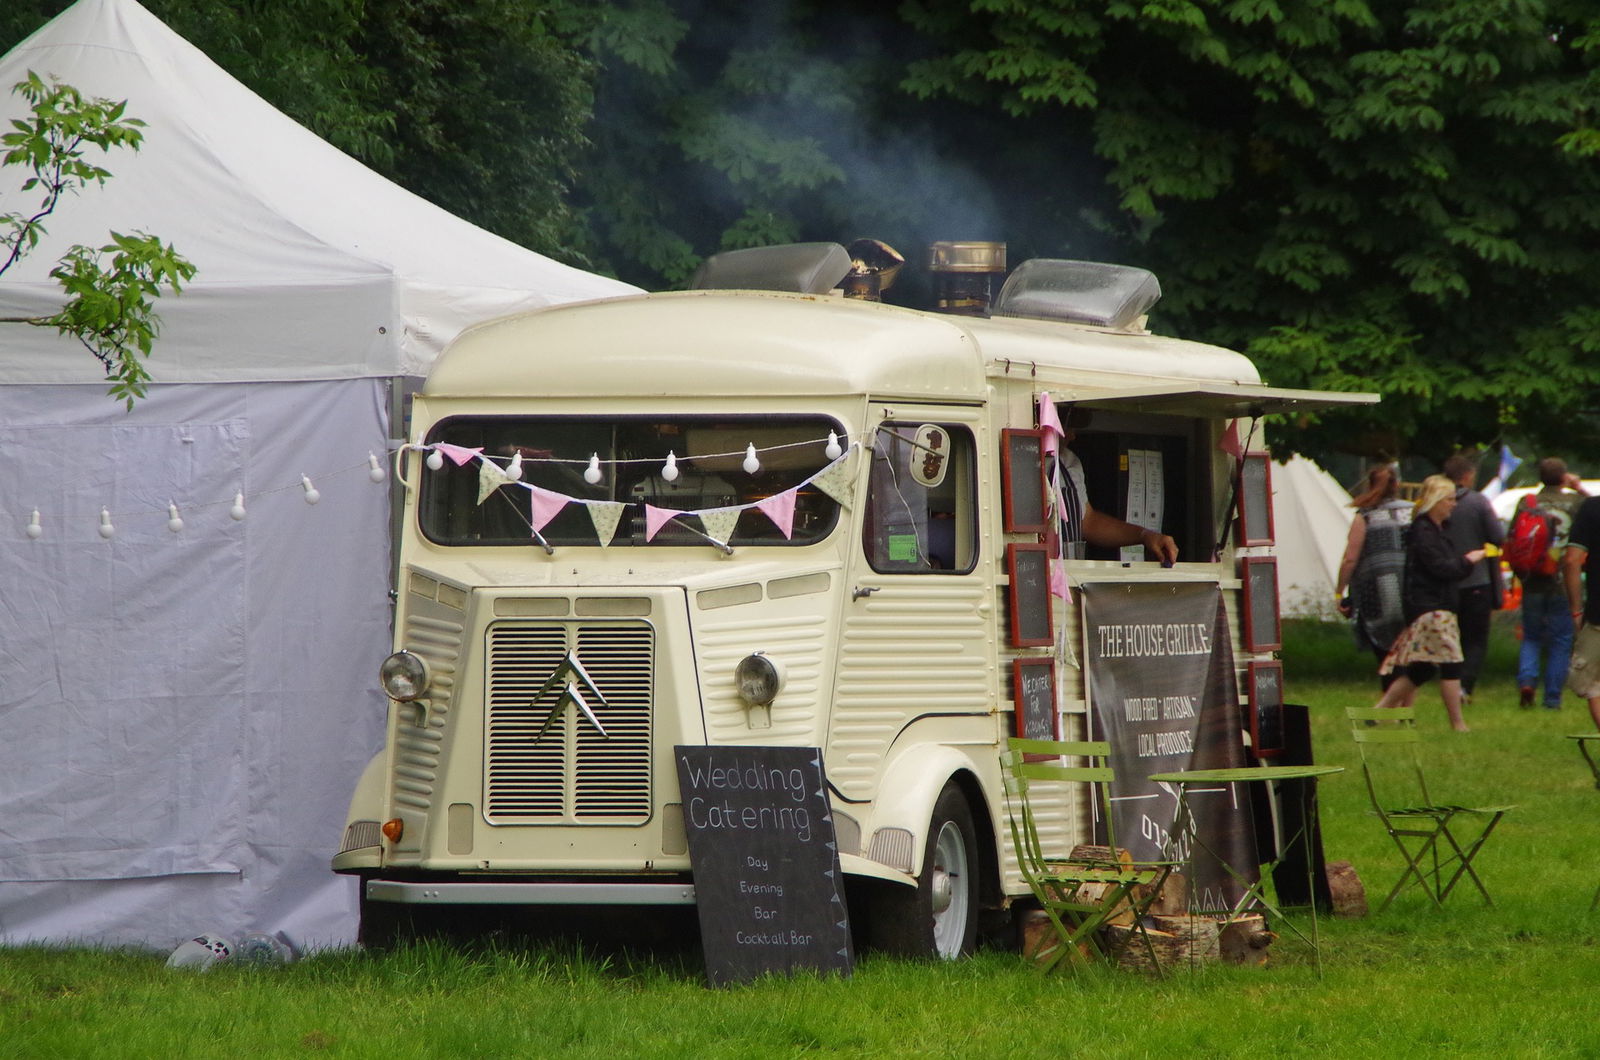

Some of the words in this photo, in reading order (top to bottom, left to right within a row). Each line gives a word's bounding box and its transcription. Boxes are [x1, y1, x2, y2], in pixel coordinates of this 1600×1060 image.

[1098, 625, 1123, 658] THE
[1125, 624, 1165, 657] HOUSE
[1165, 623, 1212, 656] GRILLE
[1124, 698, 1143, 722] WOOD
[1163, 696, 1195, 720] ARTISAN
[1138, 733, 1158, 757] LOCAL
[1156, 730, 1194, 756] PRODUCE
[682, 755, 806, 801] Wedding
[690, 797, 811, 842] Catering
[747, 856, 769, 871] Day
[740, 881, 783, 896] Evening
[754, 906, 777, 920] Bar
[736, 931, 789, 945] Cocktail
[790, 931, 813, 945] Bar
